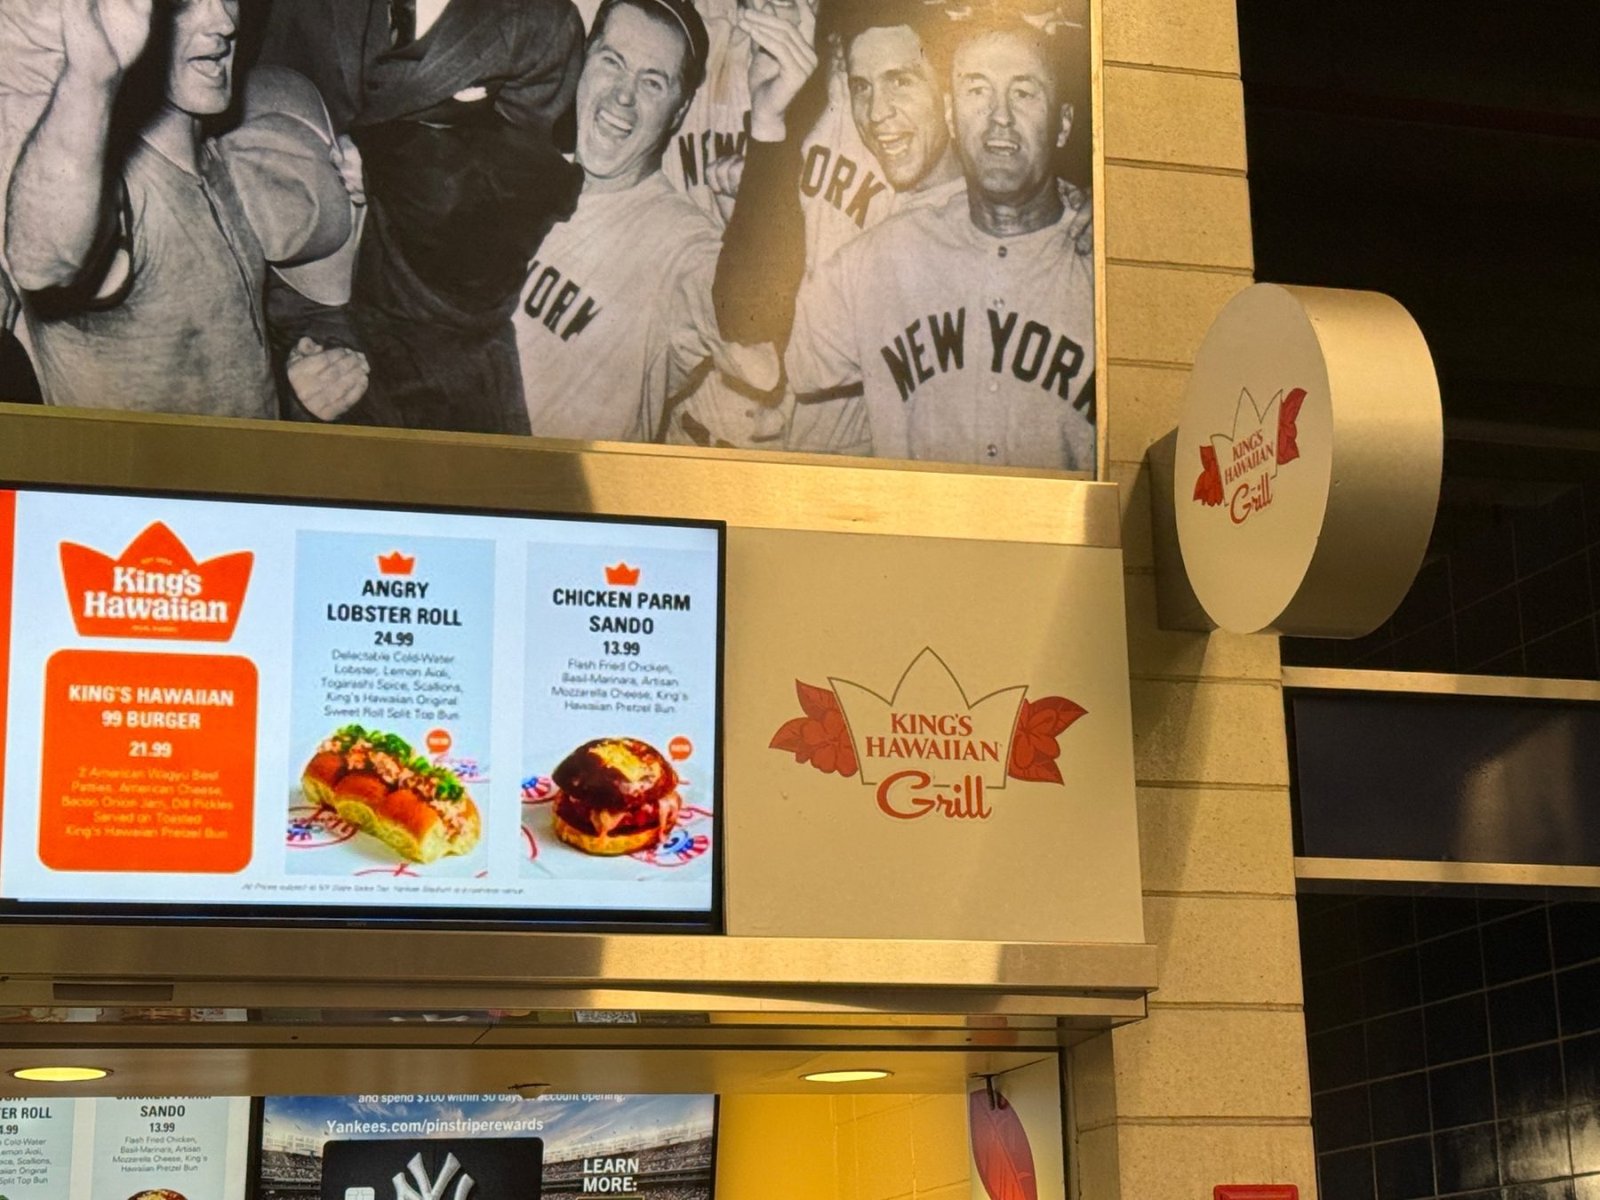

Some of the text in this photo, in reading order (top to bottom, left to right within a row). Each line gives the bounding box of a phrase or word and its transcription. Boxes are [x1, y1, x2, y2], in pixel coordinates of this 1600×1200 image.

[800, 144, 886, 229] ORK
[881, 307, 965, 402] NEW
[1225, 441, 1274, 485] HAWAIIAN
[1230, 472, 1273, 524] Grill
[113, 566, 202, 597] King's
[362, 580, 429, 599] ANGRY
[84, 591, 229, 623] Hawaiian
[552, 588, 691, 611] CHICKEN PARM
[327, 604, 462, 626] LOBSTER ROLL
[589, 615, 654, 634] SANDO
[374, 631, 414, 647] 24.99
[603, 641, 640, 656] 13.99
[384, 666, 421, 677] Lemon
[69, 684, 234, 707] KING'S HAWAIIAN
[101, 710, 201, 729] 99 BURGER
[891, 713, 973, 737] KING'S
[129, 741, 172, 758] 21.99
[865, 736, 1000, 762] HAWAIIAN
[876, 770, 992, 820] Grill
[0, 1107, 53, 1119] ER ROLL
[140, 1105, 185, 1117] SANDO
[150, 1122, 175, 1133] 13.99
[326, 1118, 544, 1135] Yankees.com/pinstriperewards
[583, 1159, 639, 1174] LEARN
[583, 1176, 638, 1192] MORE:
